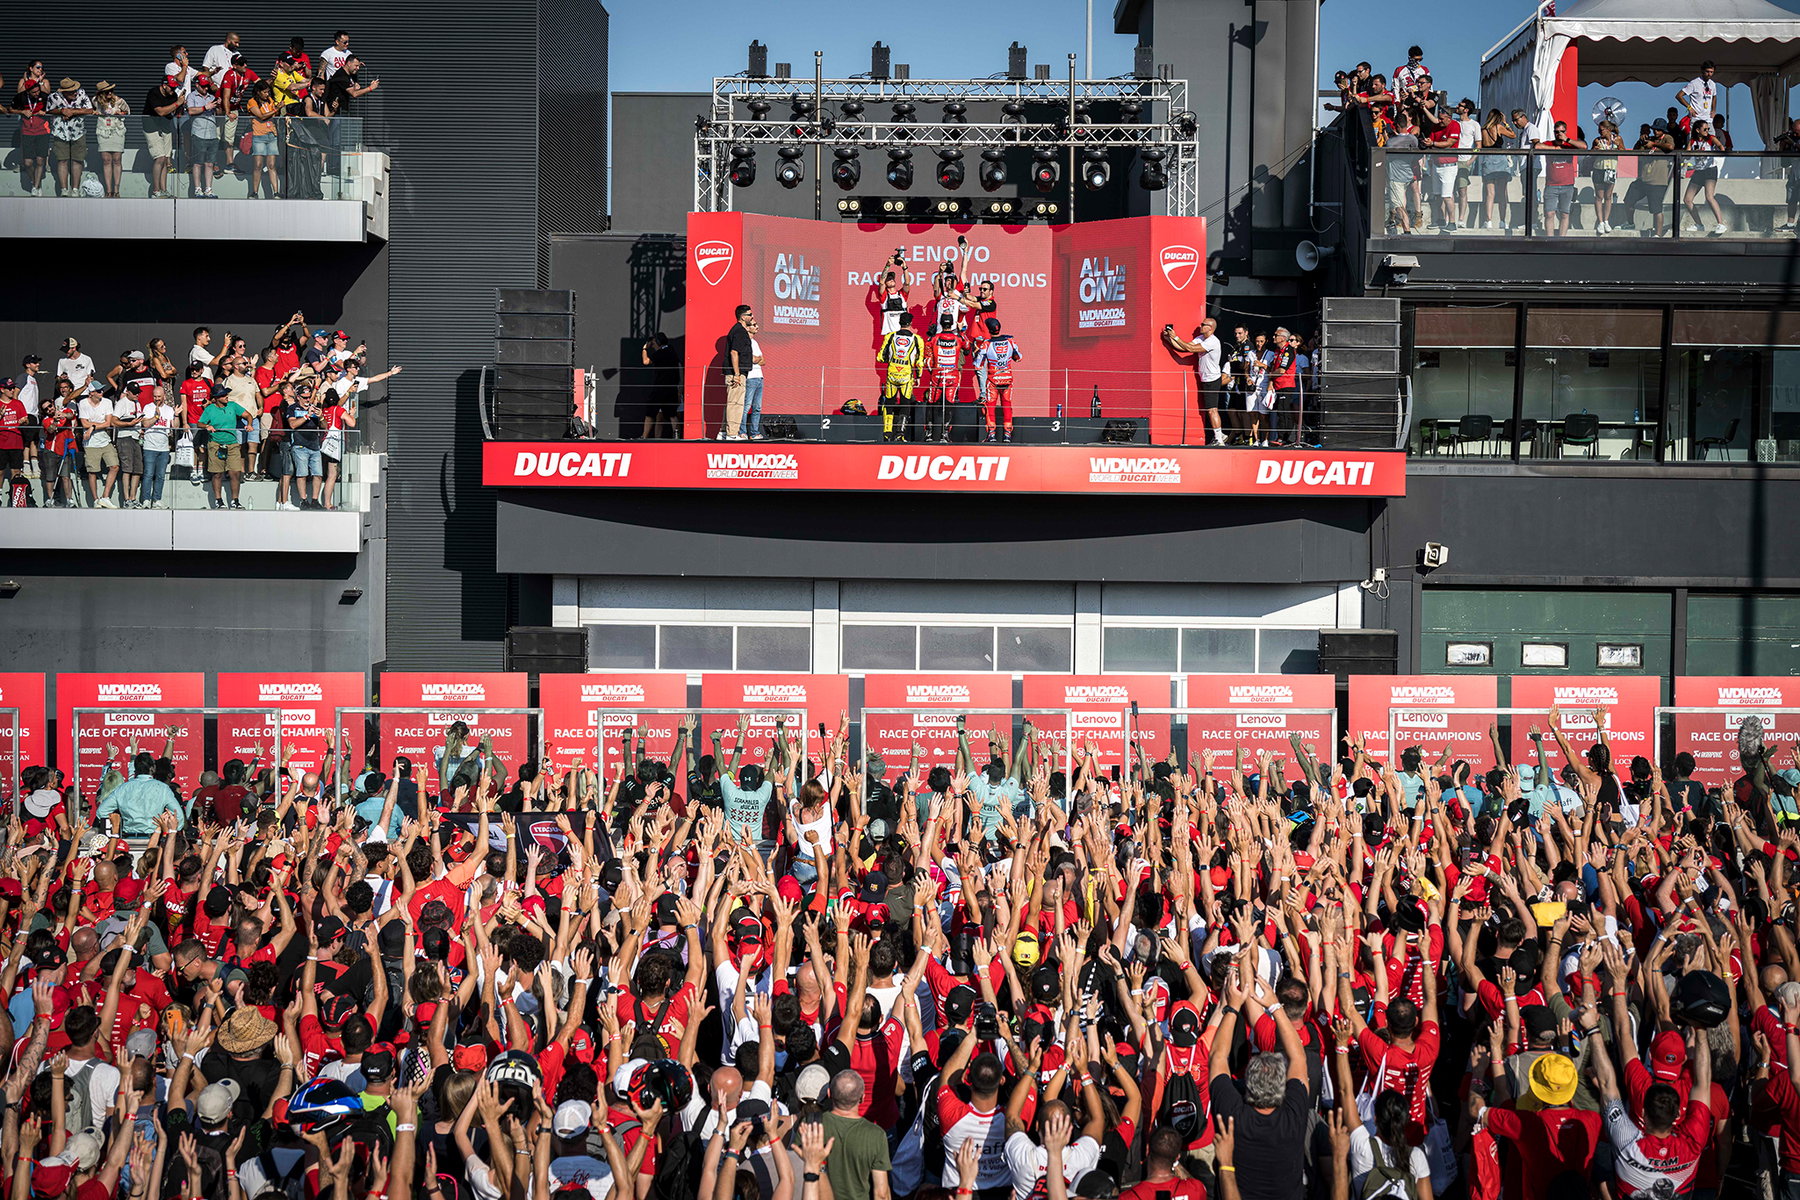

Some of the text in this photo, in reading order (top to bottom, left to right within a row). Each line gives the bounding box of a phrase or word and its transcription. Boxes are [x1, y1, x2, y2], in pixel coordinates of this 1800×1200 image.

[774, 253, 809, 274] ALL
[1080, 256, 1114, 278] ALL
[774, 274, 820, 301] ONE
[1080, 276, 1126, 303] ONE
[774, 305, 820, 318] WDW2024
[1080, 308, 1125, 320] WDW2024
[822, 418, 830, 430] 2
[1051, 420, 1060, 432] 3
[514, 452, 632, 478] DUCATI
[706, 454, 798, 469] WDW2024
[1089, 458, 1181, 473] WDW2024
[877, 455, 1010, 481] DUCATI
[1256, 460, 1374, 486] DUCATI
[98, 684, 161, 695] WDW2024
[259, 684, 322, 695] WDW2024
[422, 684, 485, 695] WDW2024
[581, 685, 644, 695] WDW2024
[743, 685, 806, 695] WDW2024
[907, 685, 970, 695] WDW2024
[1065, 686, 1128, 696] WDW2024
[1230, 686, 1292, 696] WDW2024
[1391, 687, 1455, 697] WDW2024
[1554, 687, 1618, 697] WDW2024
[1718, 688, 1782, 698] WDW2024
[1076, 715, 1116, 723] Lenovo
[1241, 714, 1281, 723] Lenovo
[1402, 714, 1443, 722] Lenovo
[102, 728, 117, 737] OF
[232, 728, 260, 737] RACE
[395, 728, 423, 737] RACE
[426, 728, 441, 737] OF
[554, 729, 583, 737] RACE
[748, 729, 763, 738] OF
[880, 730, 908, 738] RACE
[911, 730, 926, 738] OF
[1038, 731, 1066, 739] RACE
[1069, 731, 1084, 739] OF
[1202, 731, 1231, 739] RACE
[1234, 731, 1249, 739] OF
[1396, 732, 1410, 740] OF
[1413, 732, 1482, 740] CHAMPIONS
[1691, 733, 1720, 741] RACE
[1723, 733, 1738, 741] OF
[974, 1142, 1005, 1154] taff
[1648, 1157, 1679, 1166] TEAM
